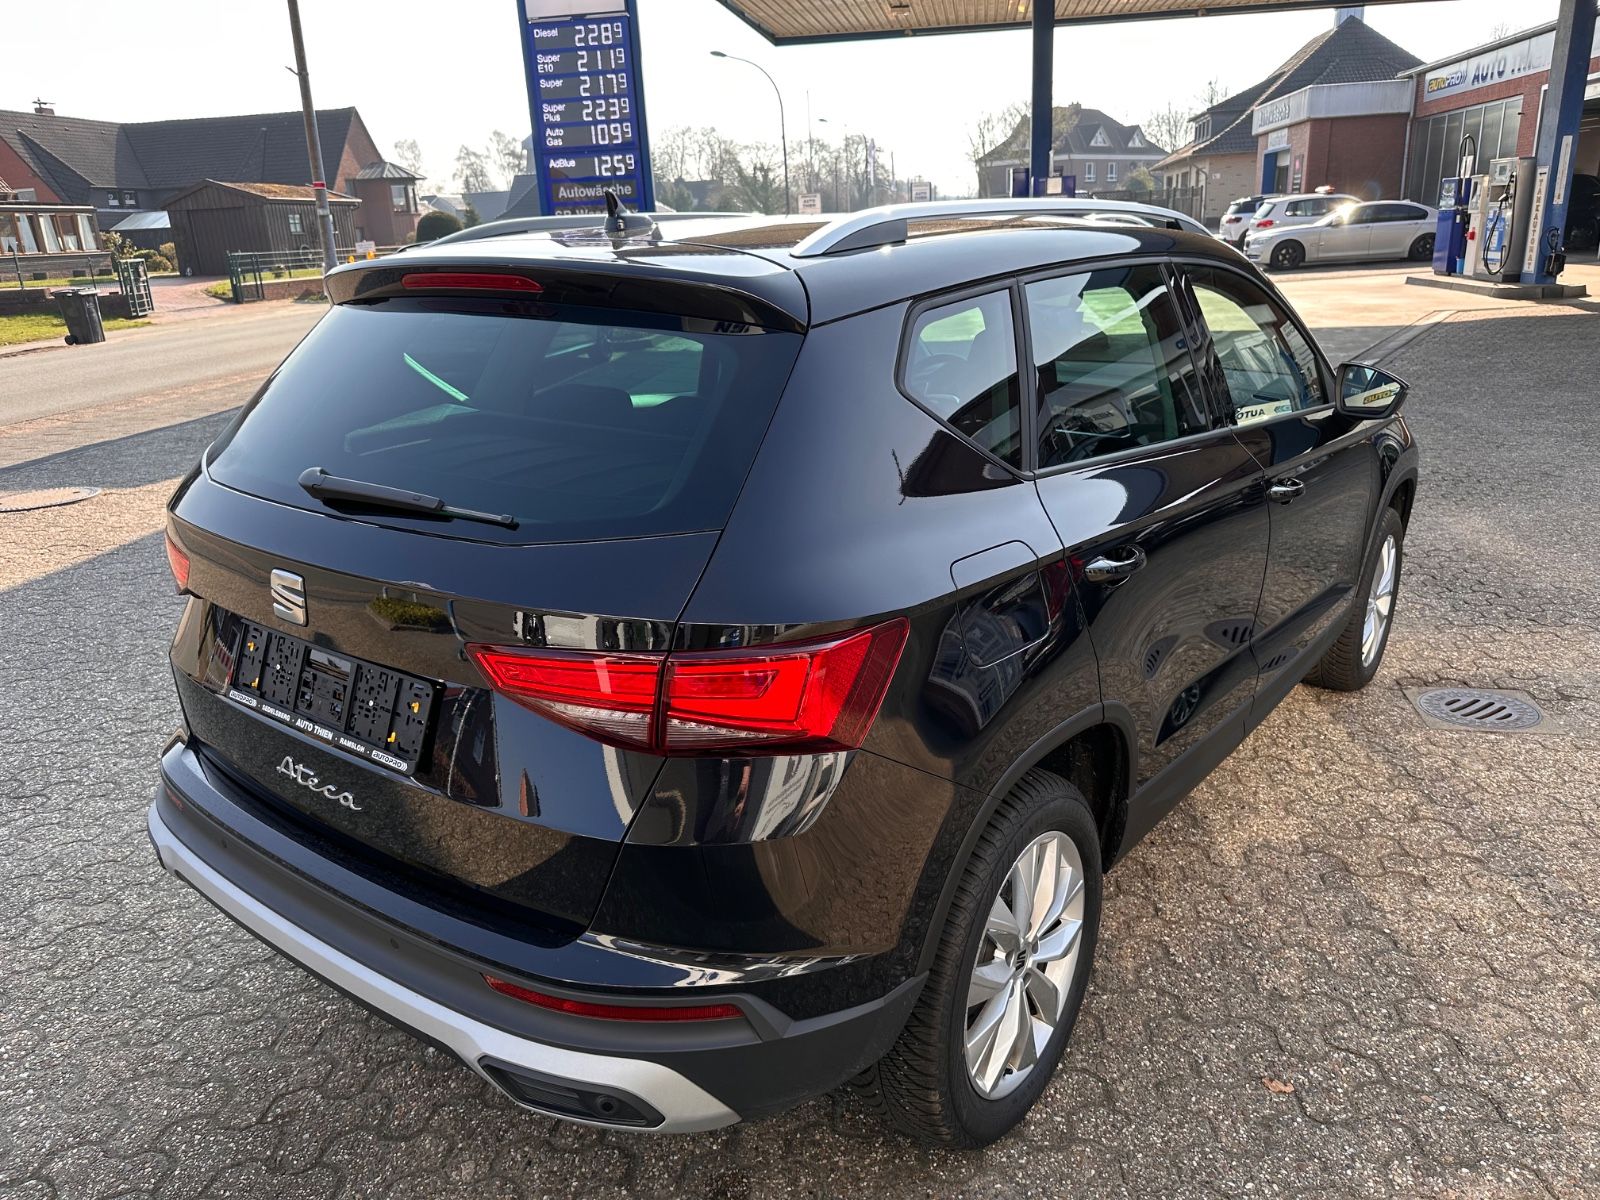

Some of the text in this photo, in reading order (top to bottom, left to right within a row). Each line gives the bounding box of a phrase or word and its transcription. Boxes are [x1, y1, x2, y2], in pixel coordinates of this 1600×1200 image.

[534, 22, 622, 47] Diesel 2289
[537, 54, 560, 63] Super
[538, 64, 554, 73] E10
[577, 48, 625, 72] 2119
[1471, 55, 1507, 86] AUTO
[540, 73, 627, 96] Super 2179
[542, 103, 566, 113] Super
[543, 113, 561, 122] Plus
[582, 98, 630, 121] 2239
[545, 128, 564, 137] Auto
[546, 137, 563, 146] Gas
[591, 122, 632, 145] 1099
[549, 154, 635, 176] AdBlue 1259
[296, 718, 313, 731] AUTO
[314, 725, 333, 741] THIEN
[276, 756, 362, 810] Ateca
